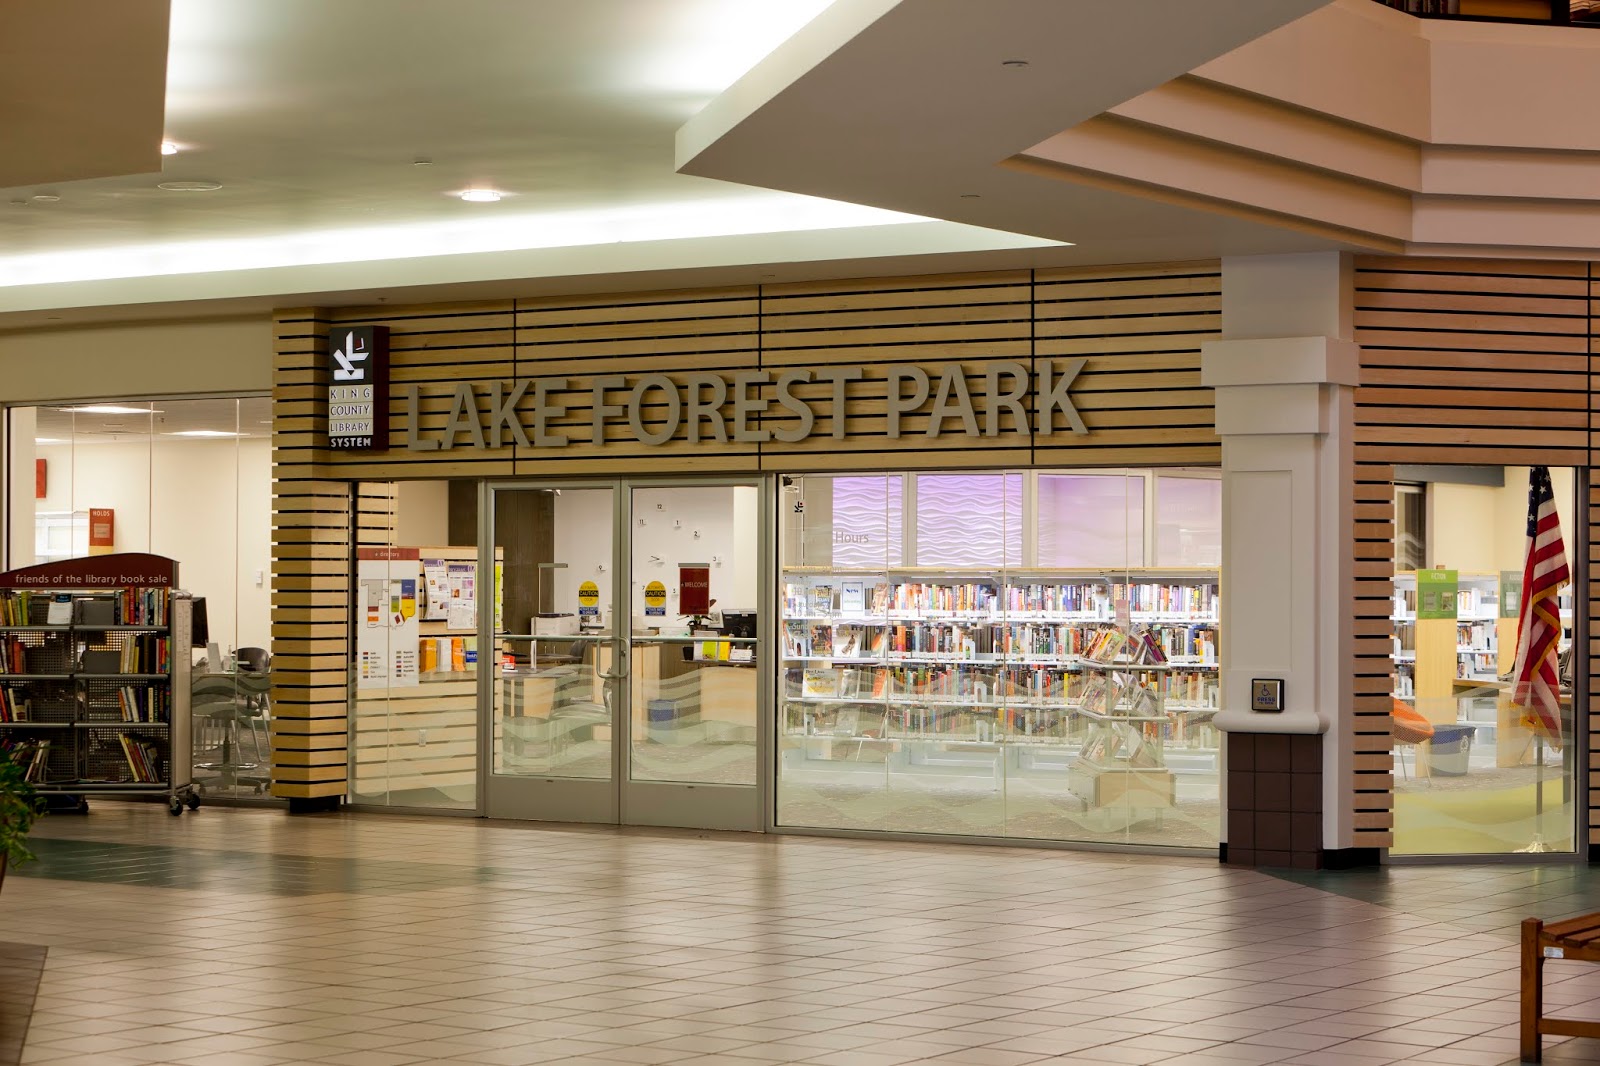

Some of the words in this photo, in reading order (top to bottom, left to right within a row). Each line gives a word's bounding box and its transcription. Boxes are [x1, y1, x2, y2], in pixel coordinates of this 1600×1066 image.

[330, 387, 370, 399] KING
[407, 378, 569, 450] LAKE
[592, 367, 863, 446] FOREST
[887, 359, 1090, 439] PARK
[330, 405, 370, 416] COUNTY
[330, 422, 370, 432] LIBRARY
[330, 437, 371, 448] SYSTEM
[835, 531, 869, 544] Hours
[15, 574, 49, 583] friends
[52, 574, 63, 583] of
[66, 574, 82, 583] the
[85, 574, 117, 585] library
[120, 574, 145, 583] book
[148, 574, 168, 583] sale
